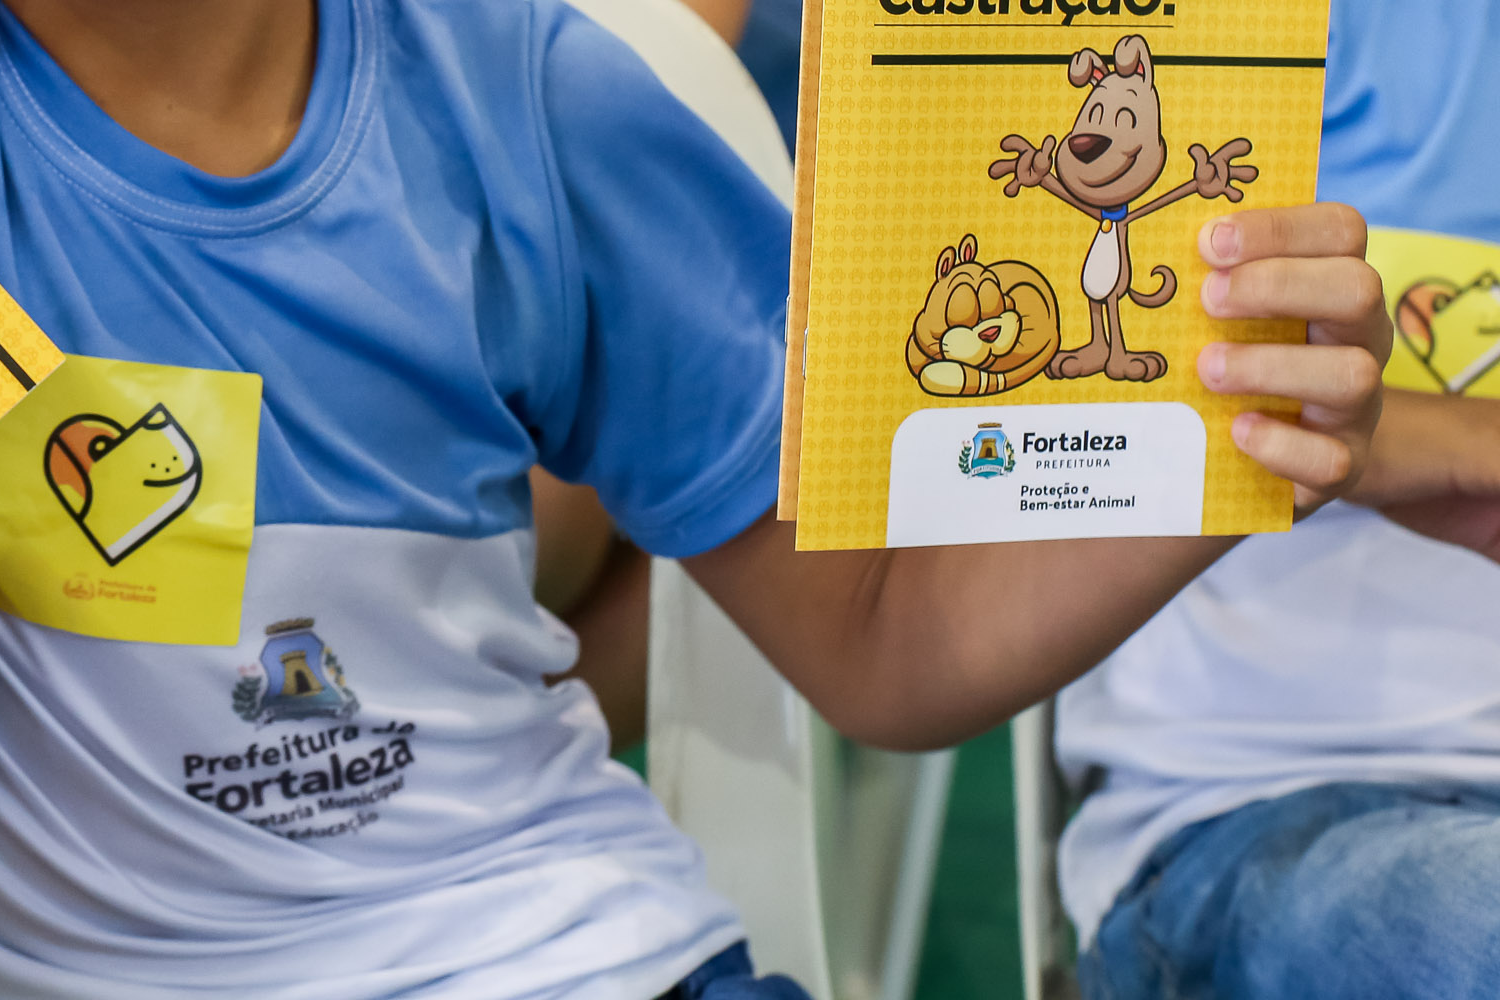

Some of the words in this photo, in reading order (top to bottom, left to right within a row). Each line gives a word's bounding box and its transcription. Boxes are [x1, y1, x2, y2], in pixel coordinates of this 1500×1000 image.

[1022, 430, 1127, 453] Fortaleza
[1036, 458, 1111, 470] PREFEITURA
[1020, 482, 1079, 499] Proteção
[1082, 485, 1089, 495] e
[1019, 498, 1085, 512] Bem-estar
[1089, 495, 1136, 509] Animal
[183, 725, 359, 778] Prefeitura
[185, 737, 415, 813] Fortaleza
